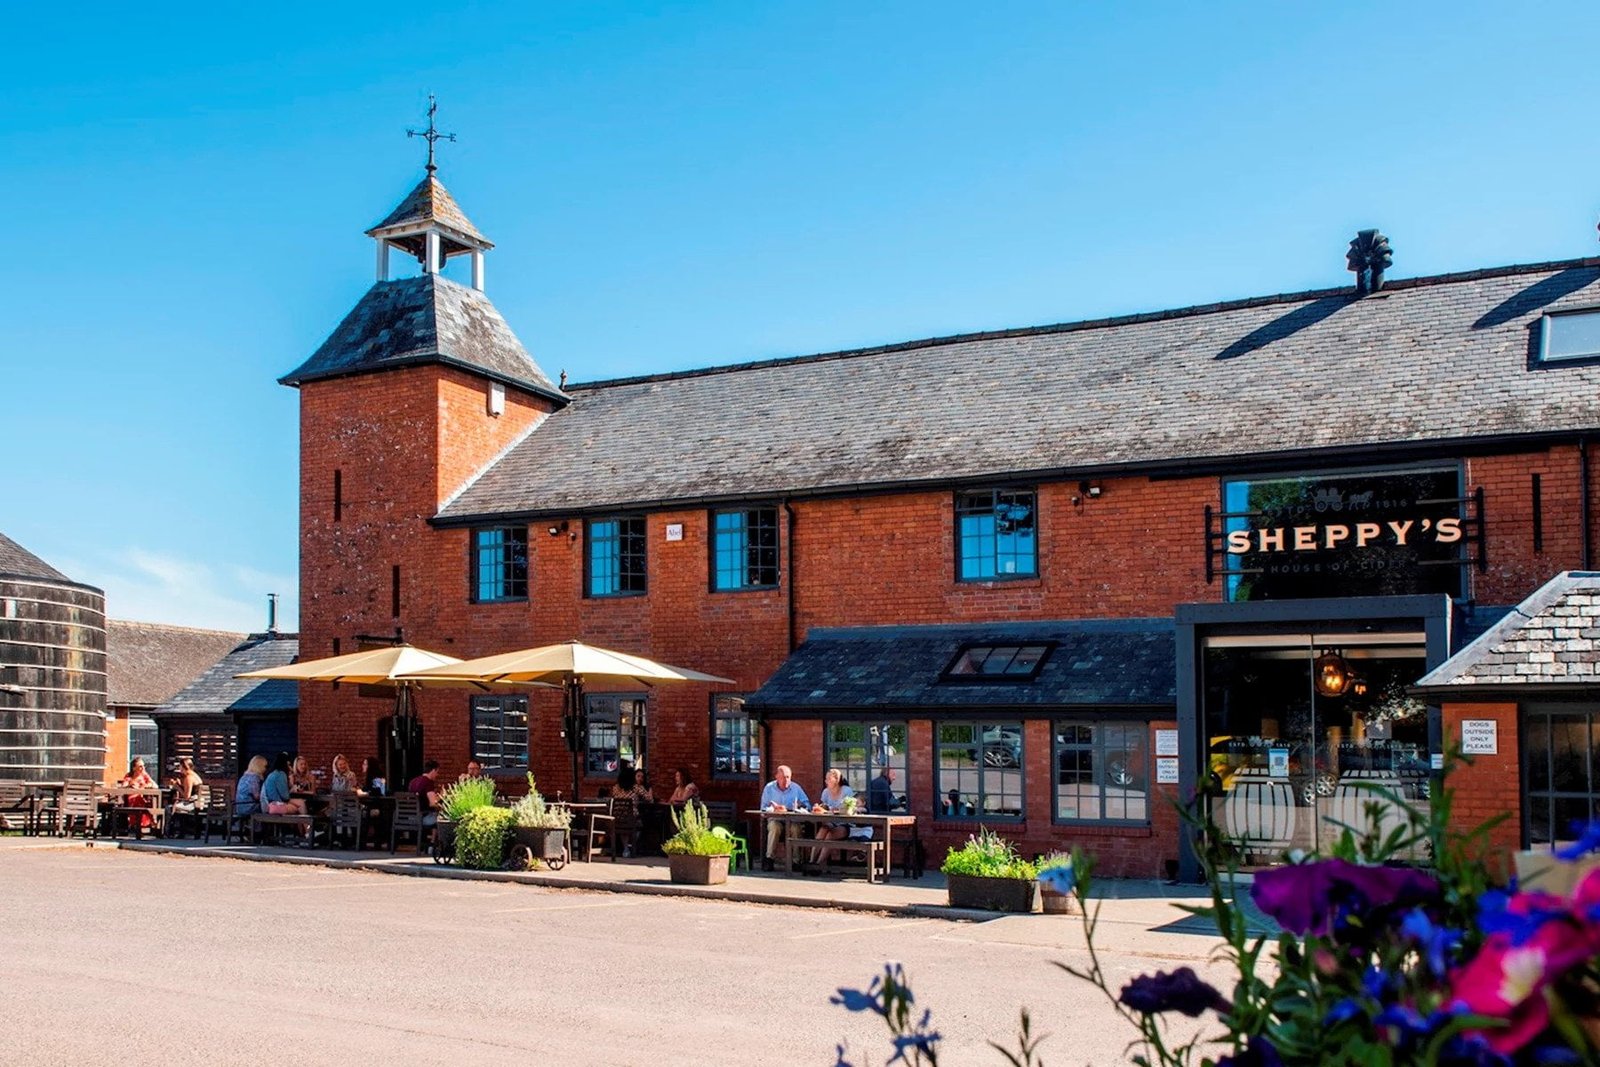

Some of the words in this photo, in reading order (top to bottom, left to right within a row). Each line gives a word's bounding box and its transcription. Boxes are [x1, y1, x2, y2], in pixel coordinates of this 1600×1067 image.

[1376, 499, 1408, 509] 1816
[1227, 517, 1462, 555] SHEPPY'S
[1270, 562, 1321, 573] HOUSE
[1331, 562, 1350, 572] OF
[1360, 560, 1406, 571] CIDER
